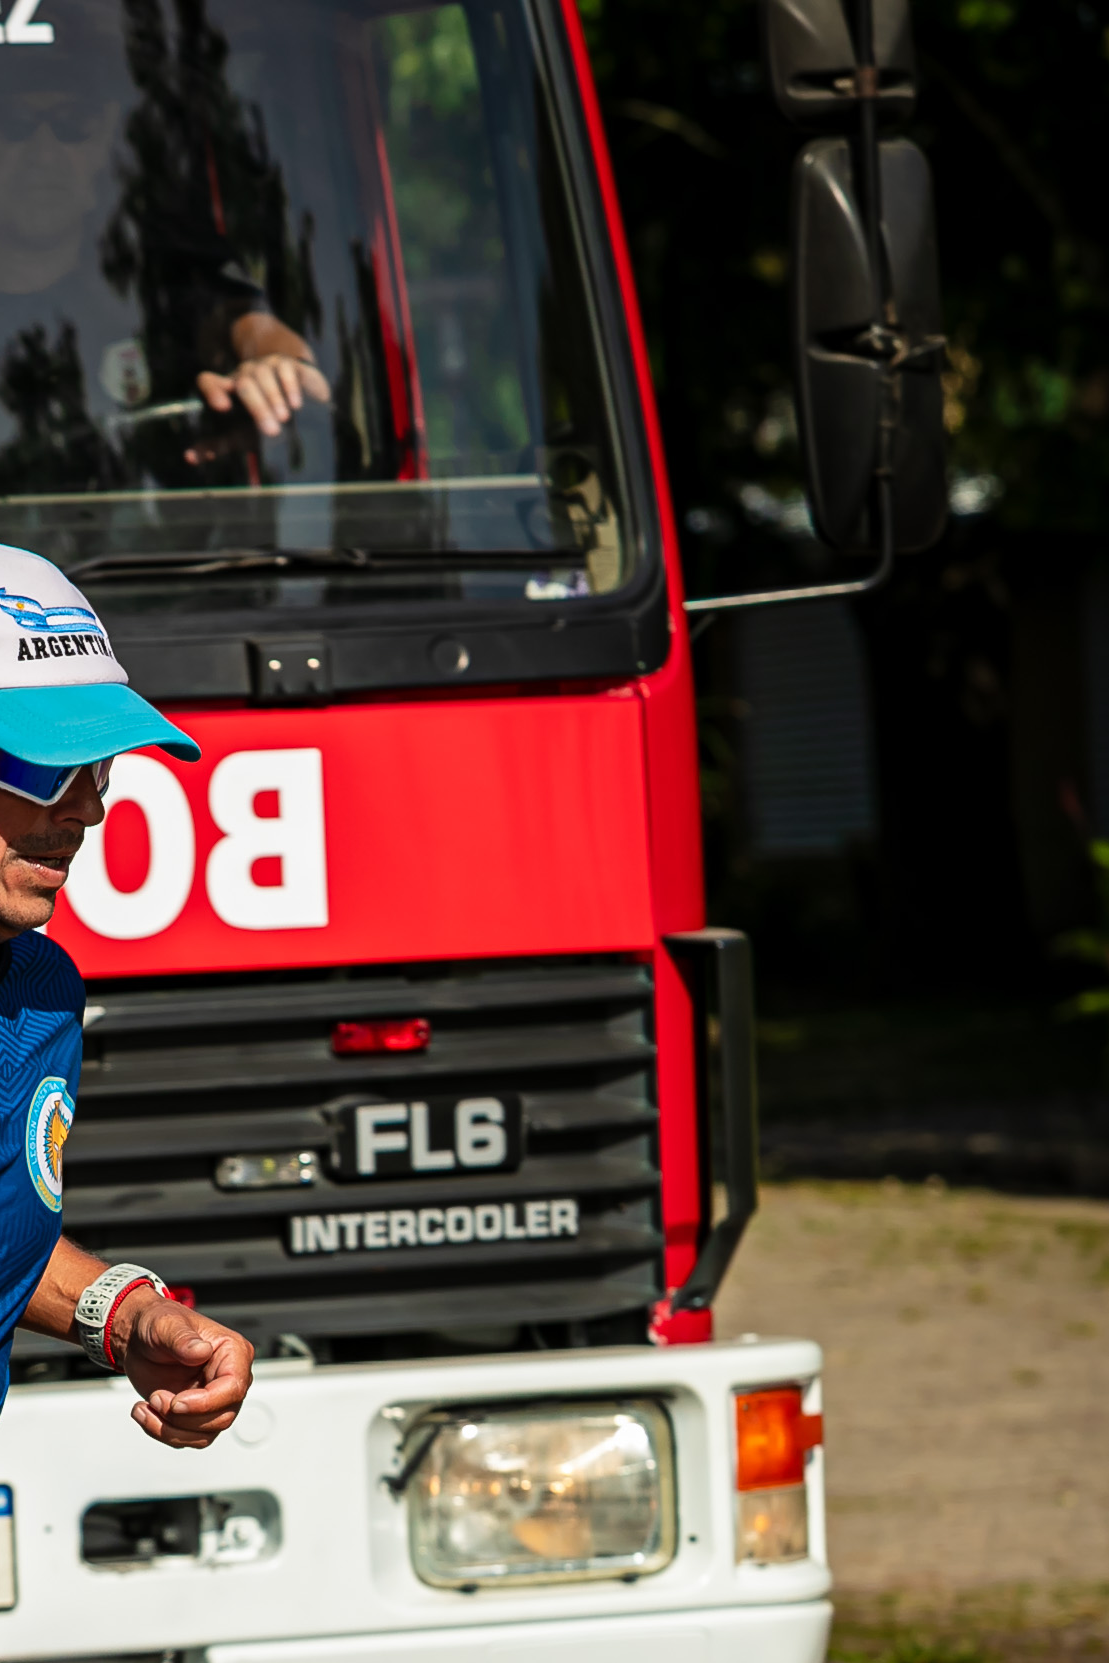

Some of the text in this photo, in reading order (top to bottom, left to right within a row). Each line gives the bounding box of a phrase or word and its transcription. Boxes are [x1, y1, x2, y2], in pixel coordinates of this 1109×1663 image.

[18, 633, 114, 661] ARGENTIN
[356, 1098, 507, 1175] FL6
[293, 1200, 579, 1253] INTERCOOLER
